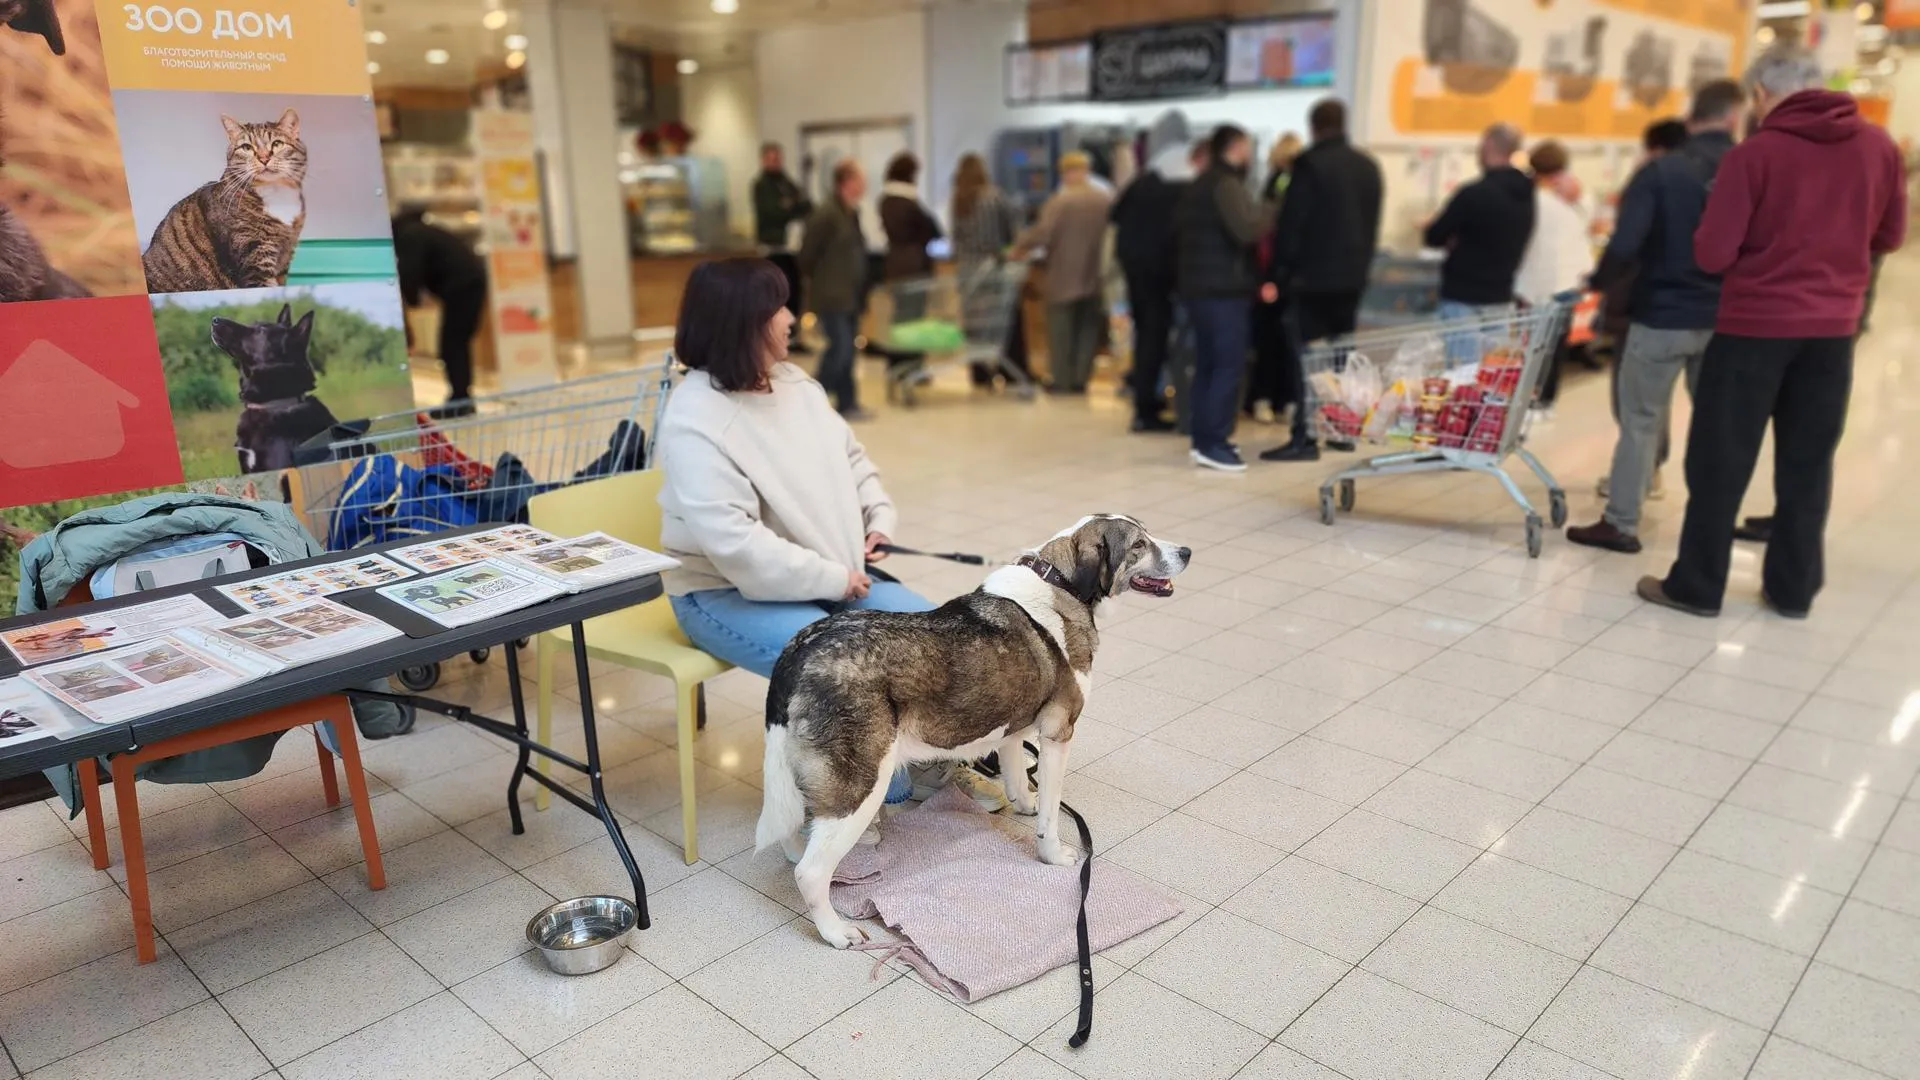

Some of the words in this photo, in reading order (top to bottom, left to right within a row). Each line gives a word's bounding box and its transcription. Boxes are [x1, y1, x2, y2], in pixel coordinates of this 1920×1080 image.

[123, 4, 202, 34] ЗОО
[212, 10, 293, 40] ДОМ
[143, 46, 255, 60] БЛАГОТВОРИТЕЛЬНЫЙ
[256, 52, 286, 62] ФОНД
[161, 58, 211, 69] ПОМОЩИ
[212, 60, 271, 71] ЖИВОТНЫМ
